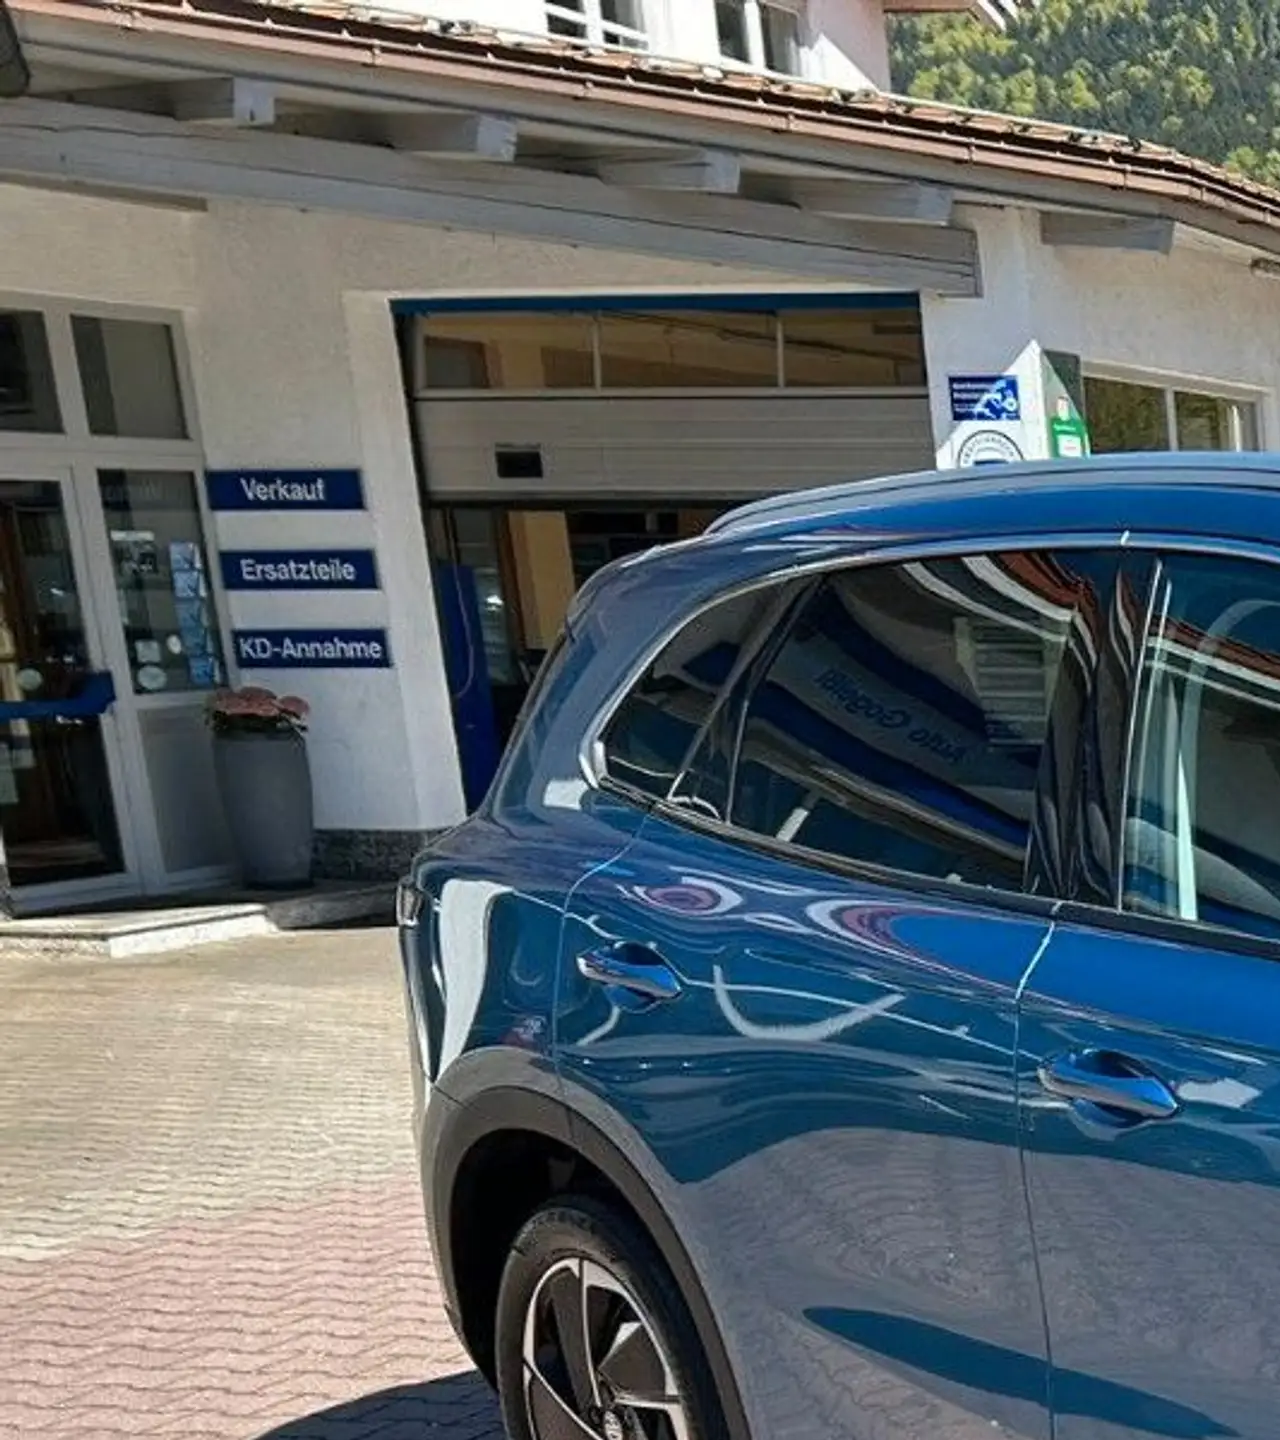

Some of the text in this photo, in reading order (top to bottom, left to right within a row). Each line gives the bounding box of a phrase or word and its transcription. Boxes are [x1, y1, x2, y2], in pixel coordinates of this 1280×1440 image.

[240, 477, 325, 500] Verkauf
[240, 557, 357, 581] Ersatzteile
[239, 635, 383, 660] KD-Annahme
